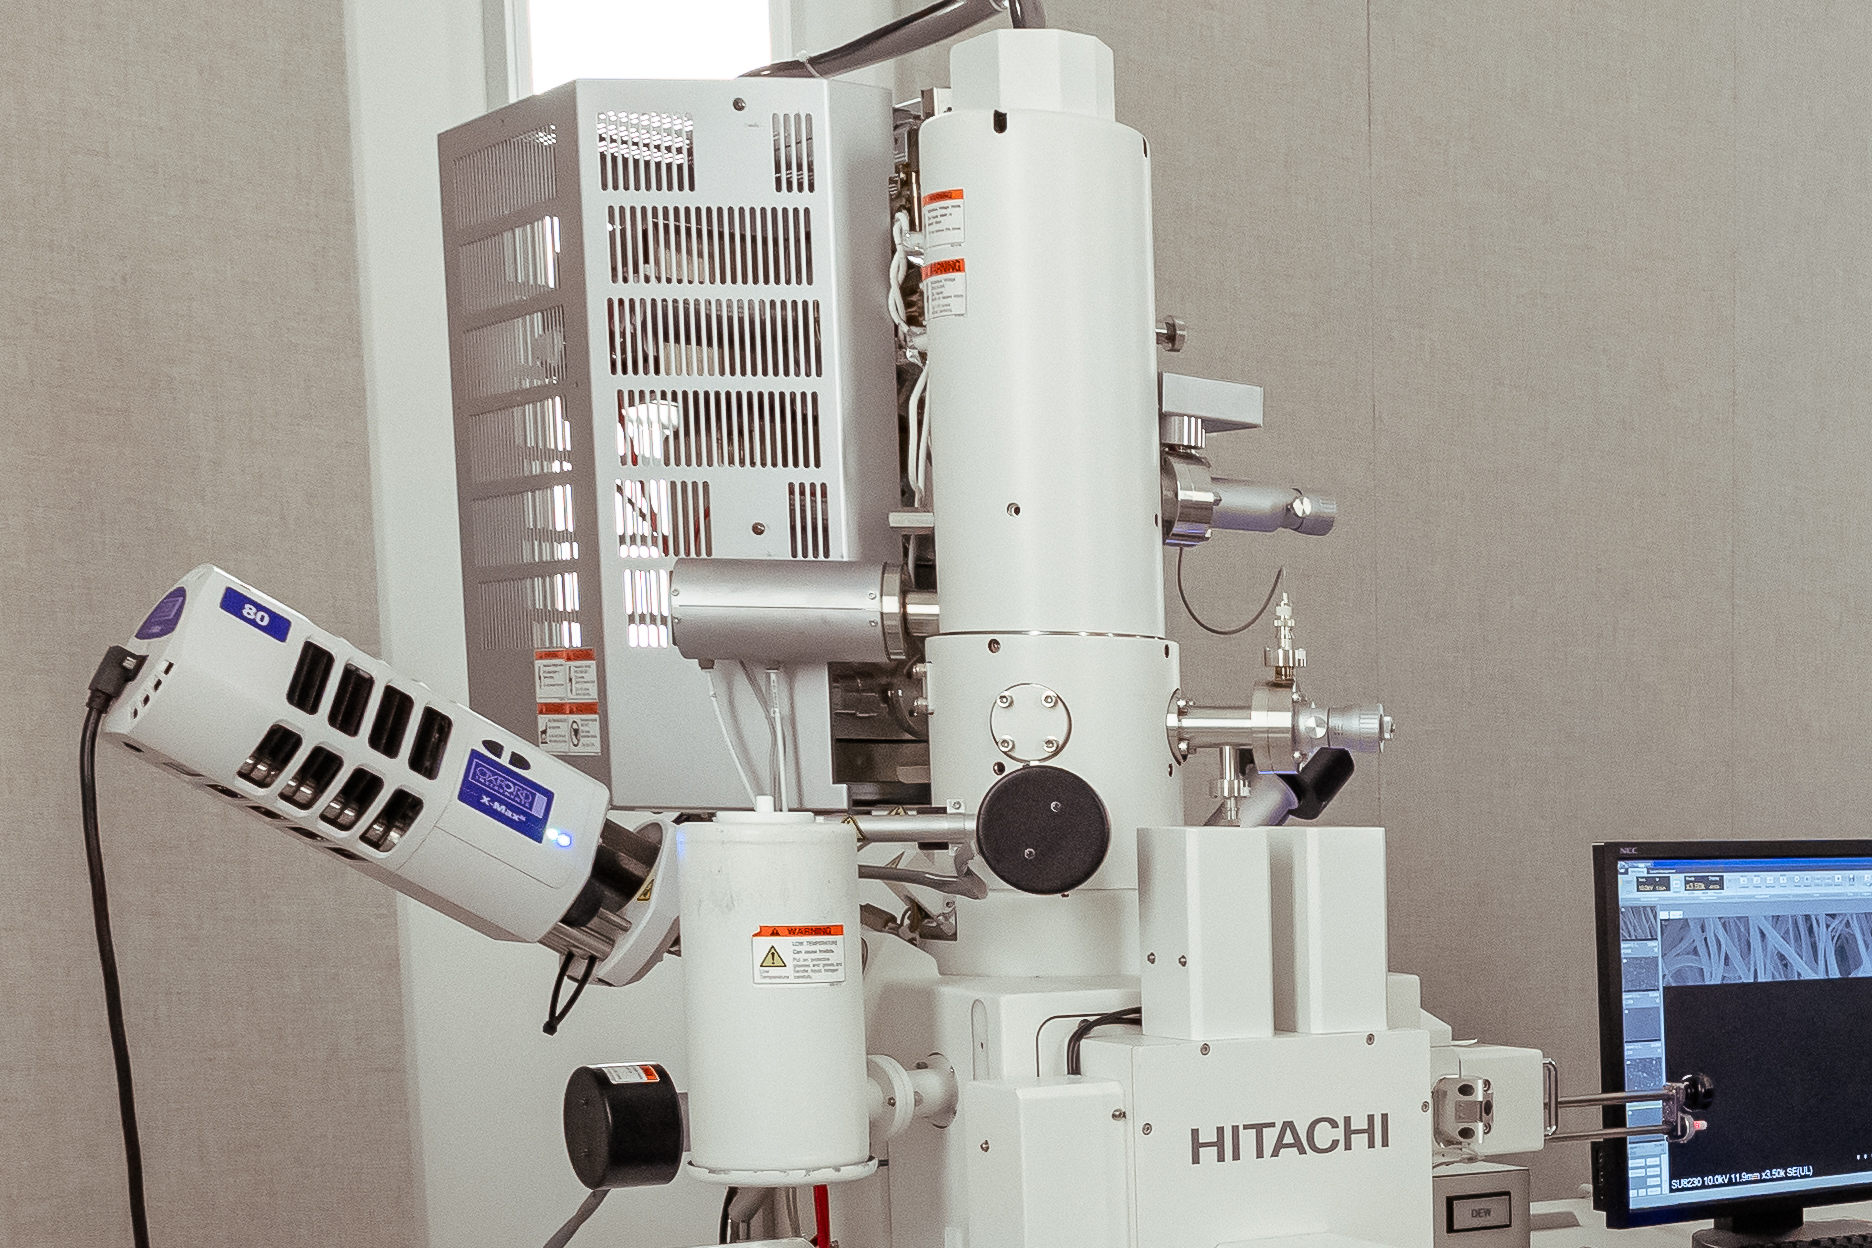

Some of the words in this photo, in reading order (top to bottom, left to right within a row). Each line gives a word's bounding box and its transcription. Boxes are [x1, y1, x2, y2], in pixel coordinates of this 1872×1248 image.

[242, 603, 270, 627] 80
[786, 926, 832, 936] WARNING
[1191, 1112, 1390, 1165] HITACHI
[1671, 1178, 1702, 1190] SU8230
[1704, 1174, 1730, 1186] 10.0kV
[1731, 1172, 1760, 1184] 11.9mm
[1762, 1169, 1786, 1181] x3.50k
[1786, 1166, 1813, 1178] SE(UL)
